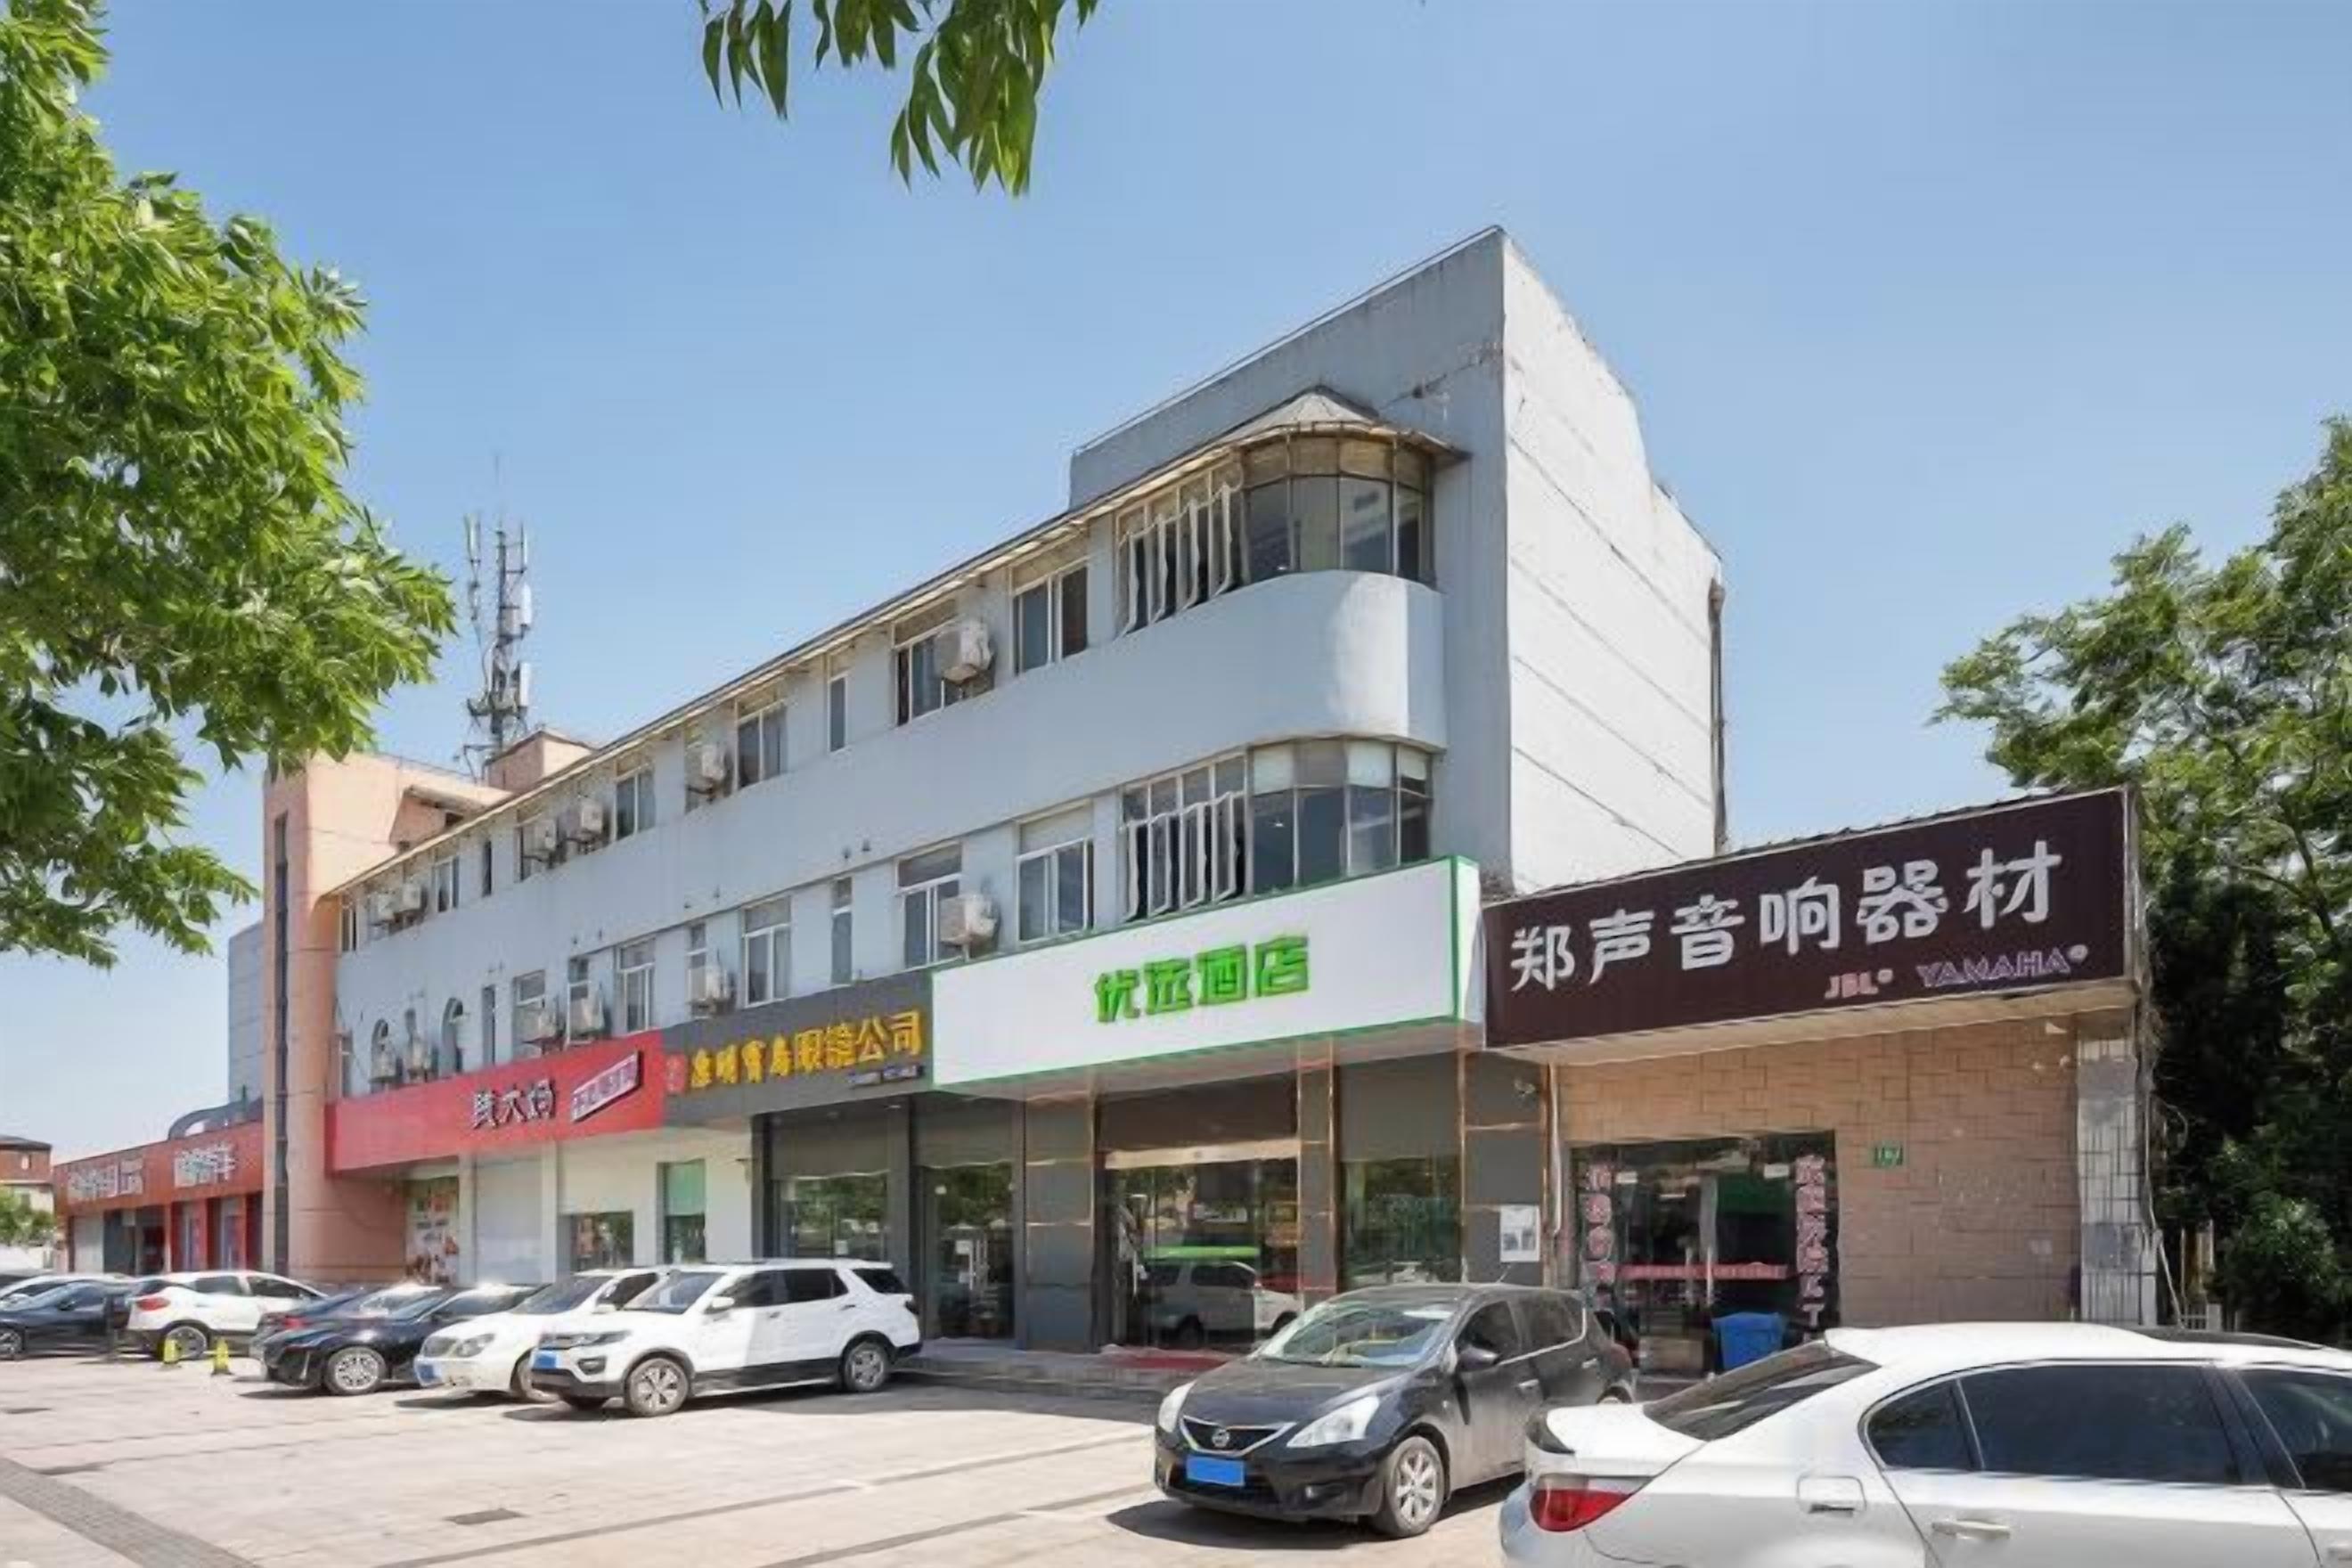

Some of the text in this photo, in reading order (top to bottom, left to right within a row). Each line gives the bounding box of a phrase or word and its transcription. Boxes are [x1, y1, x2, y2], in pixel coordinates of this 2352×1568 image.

[1509, 839, 2063, 992] 郑声音响器材
[1916, 946, 2071, 988] YAMAHA
